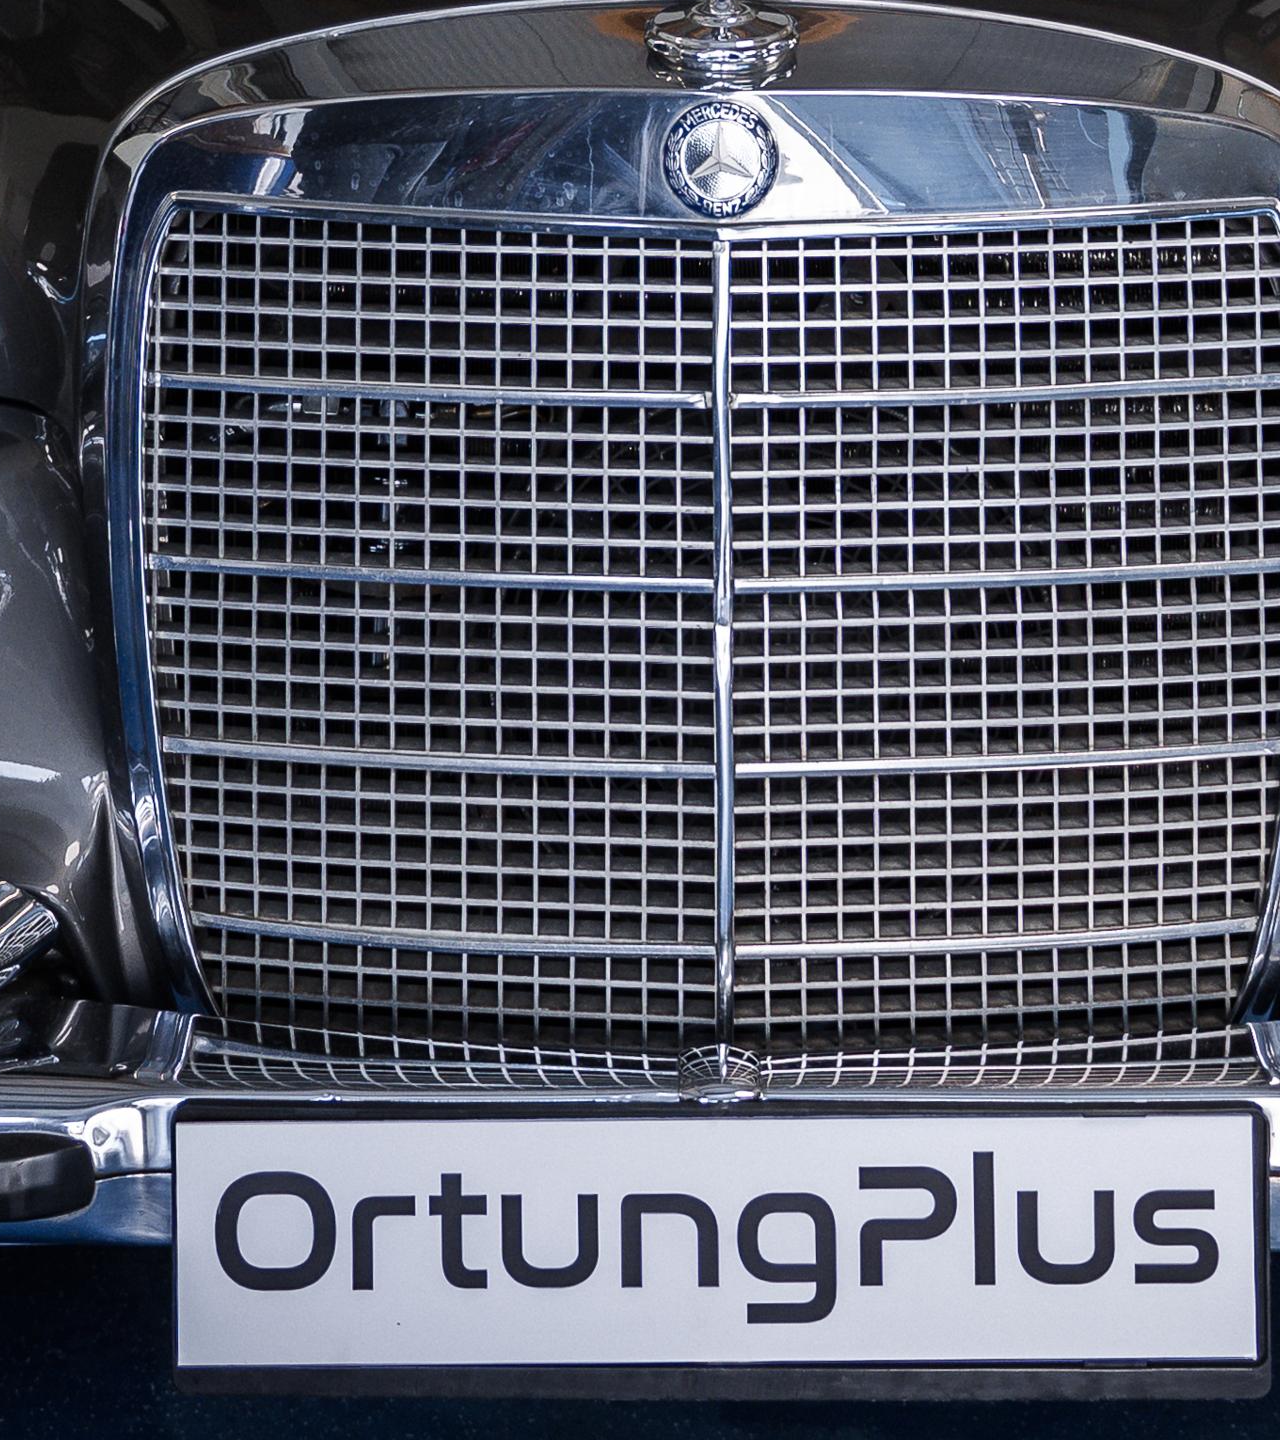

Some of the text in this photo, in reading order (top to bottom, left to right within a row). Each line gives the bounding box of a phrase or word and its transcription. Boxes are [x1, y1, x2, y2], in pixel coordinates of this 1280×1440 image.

[681, 103, 758, 131] MERCEDES
[703, 199, 742, 216] BENZ
[214, 1150, 1219, 1324] OrtungPlus
